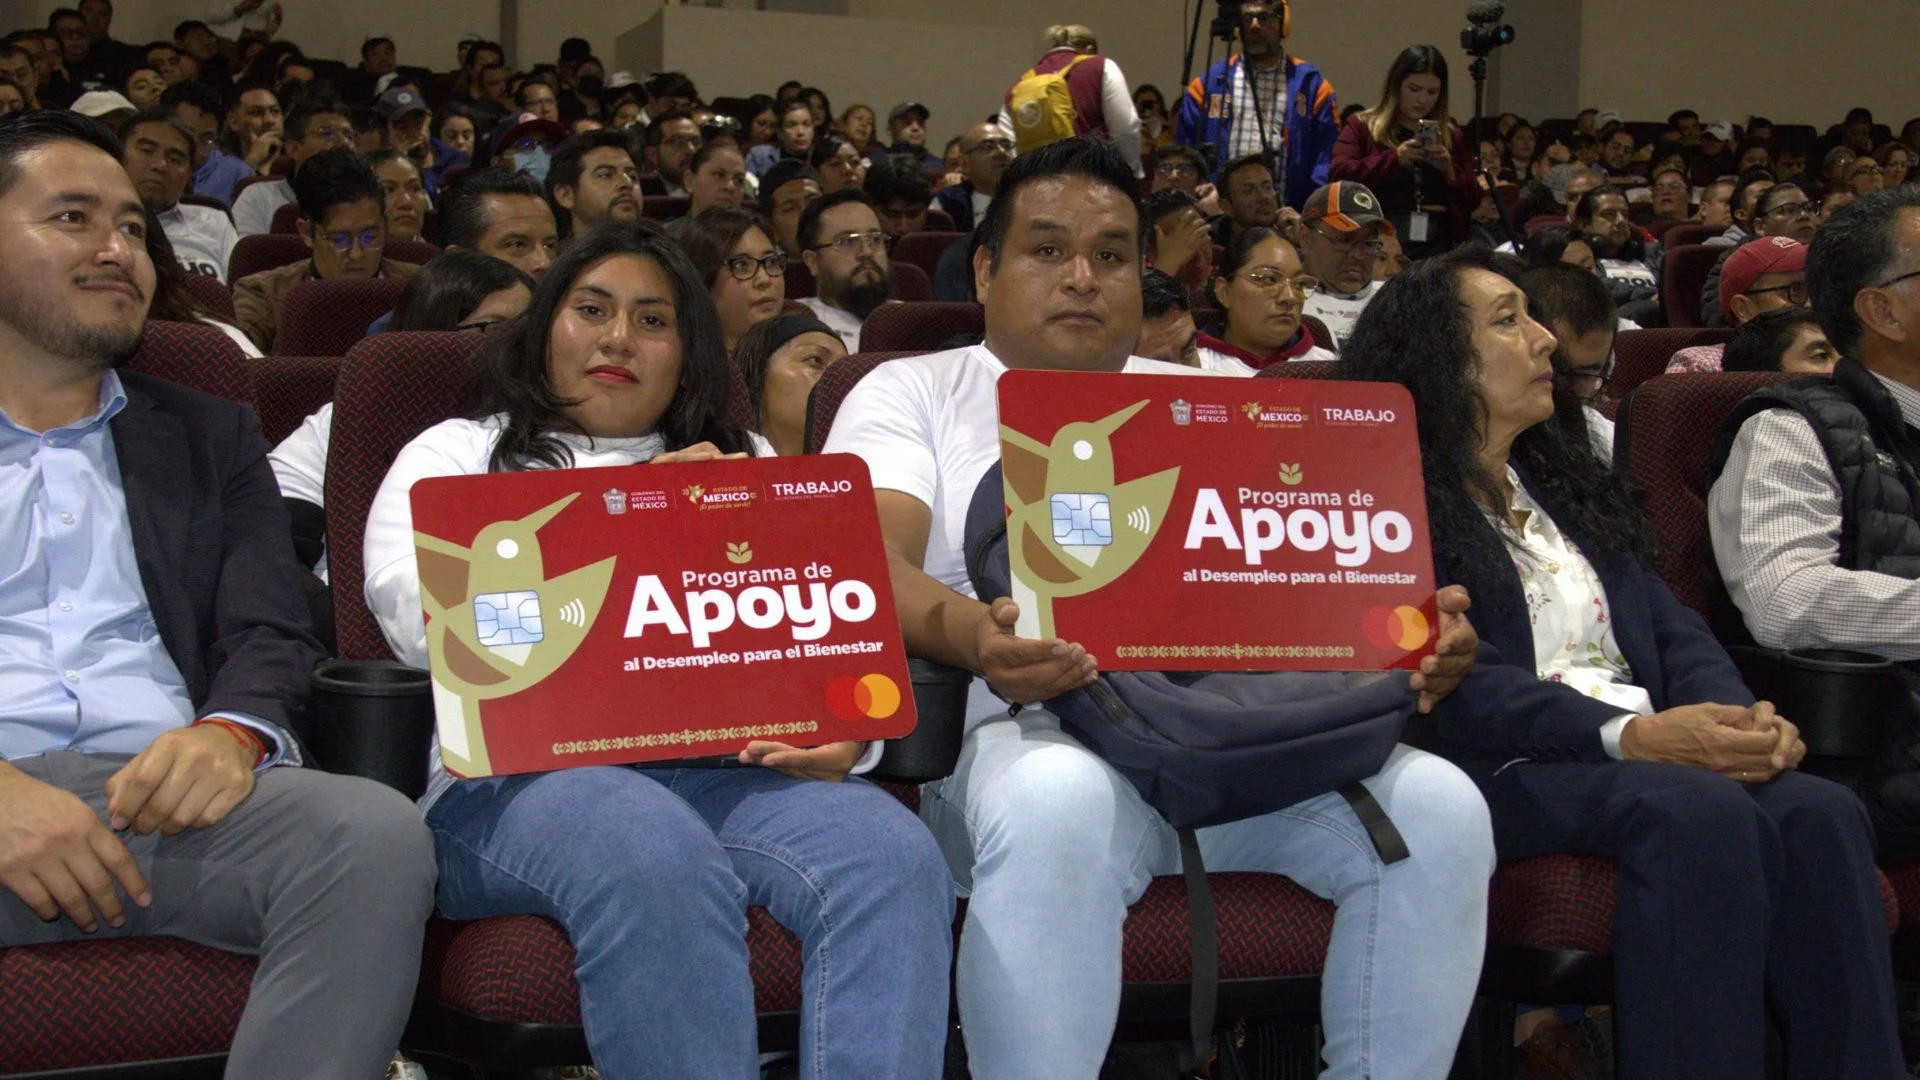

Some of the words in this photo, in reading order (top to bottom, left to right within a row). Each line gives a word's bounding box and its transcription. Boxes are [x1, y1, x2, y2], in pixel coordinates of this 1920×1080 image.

[1322, 408, 1395, 422] TRABAJO
[771, 479, 852, 496] TRABAJO
[1238, 487, 1342, 509] Programa
[1348, 489, 1375, 507] de
[632, 501, 668, 510] MÉXICO
[1183, 487, 1414, 568] Apoyo
[681, 567, 797, 589] Programa
[803, 561, 833, 580] de
[1182, 568, 1198, 582] al
[1200, 568, 1288, 585] Desempleo
[1290, 572, 1327, 586] para
[1328, 569, 1343, 584] el
[1344, 570, 1417, 585] Bienestar
[623, 574, 877, 649] Apoyo
[623, 656, 641, 672] al
[643, 650, 741, 670] Desempleo
[743, 649, 783, 665] para
[785, 645, 802, 659] el
[803, 640, 884, 658] Bienestar
